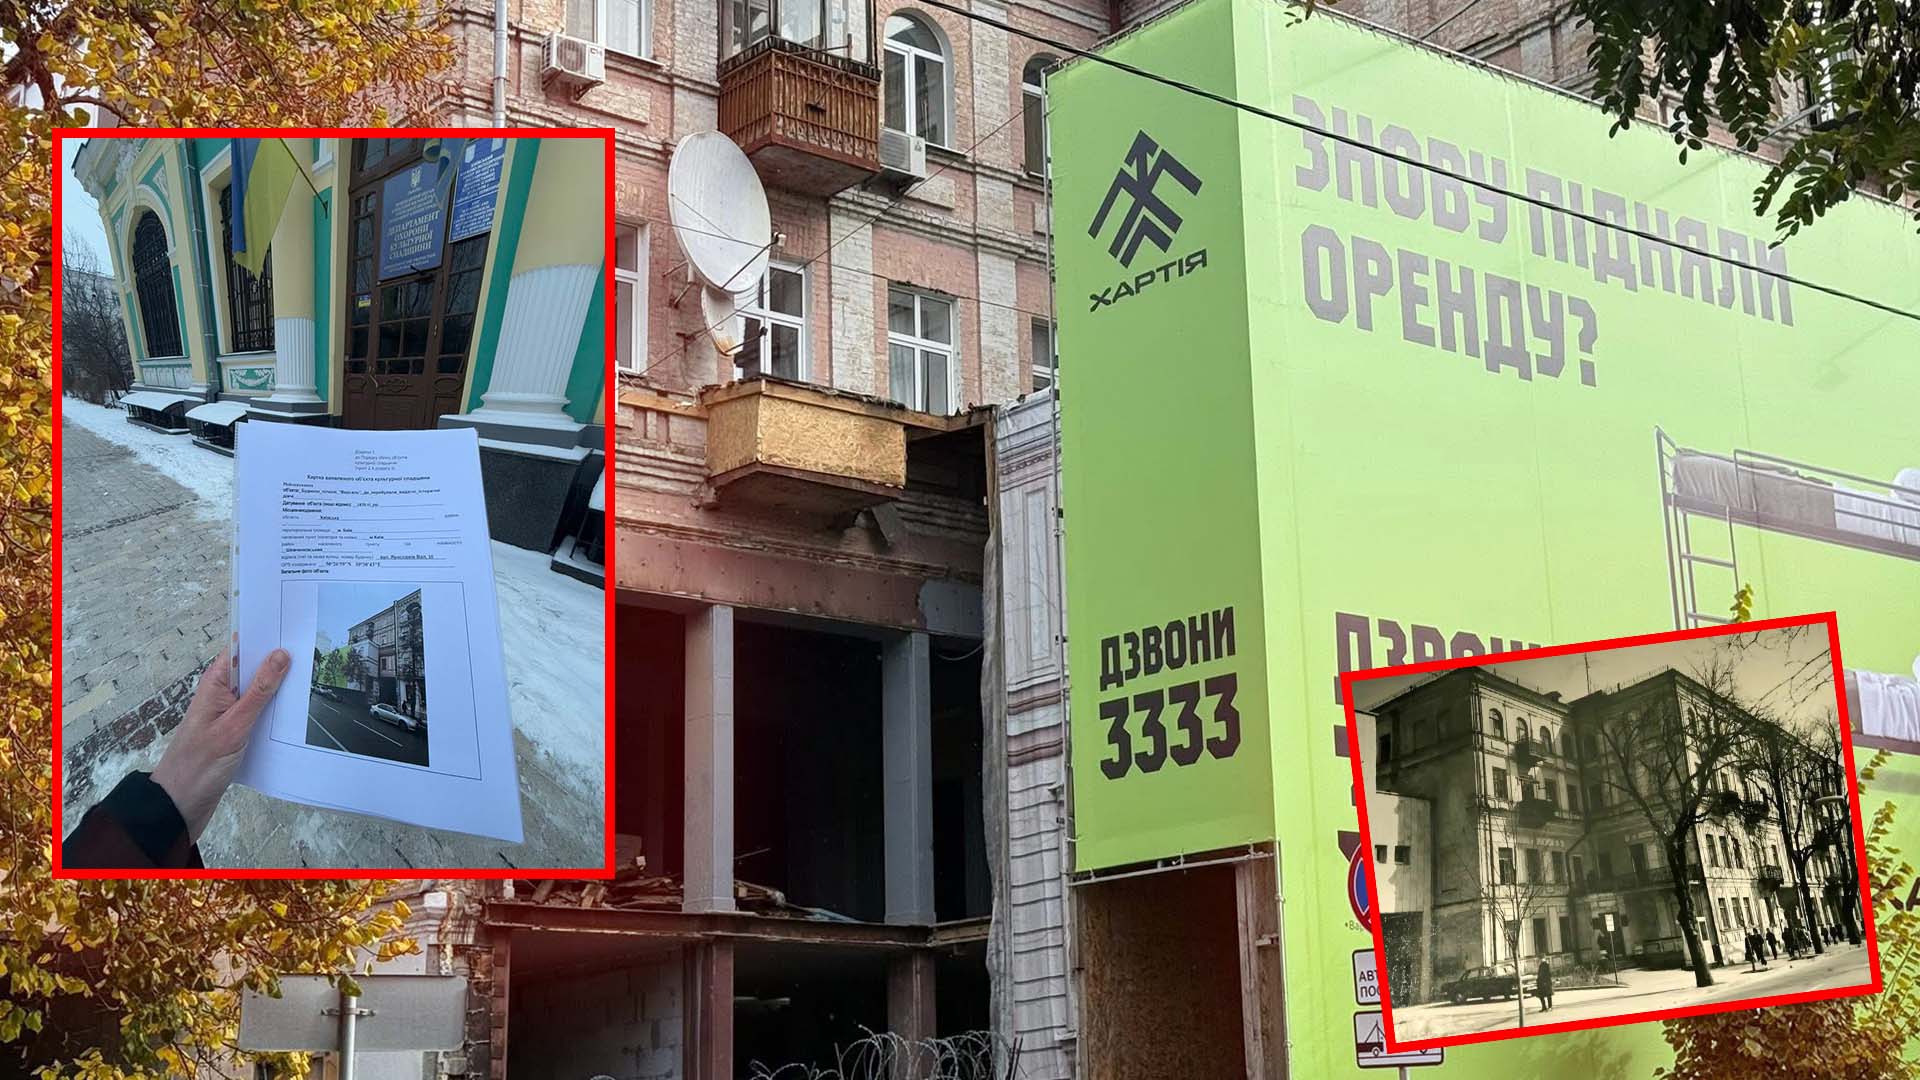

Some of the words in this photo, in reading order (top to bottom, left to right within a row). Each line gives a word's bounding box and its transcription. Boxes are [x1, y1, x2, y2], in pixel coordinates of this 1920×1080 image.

[1293, 94, 1508, 244] ЗНОВУ
[1526, 168, 1794, 327] ПІДНЯЛИ
[1090, 249, 1207, 312] ХАРТІЯ
[1301, 223, 1598, 387] ОРЕНДУ?
[1100, 606, 1236, 692] ДЗВОНИ
[1099, 672, 1241, 780] 3333
